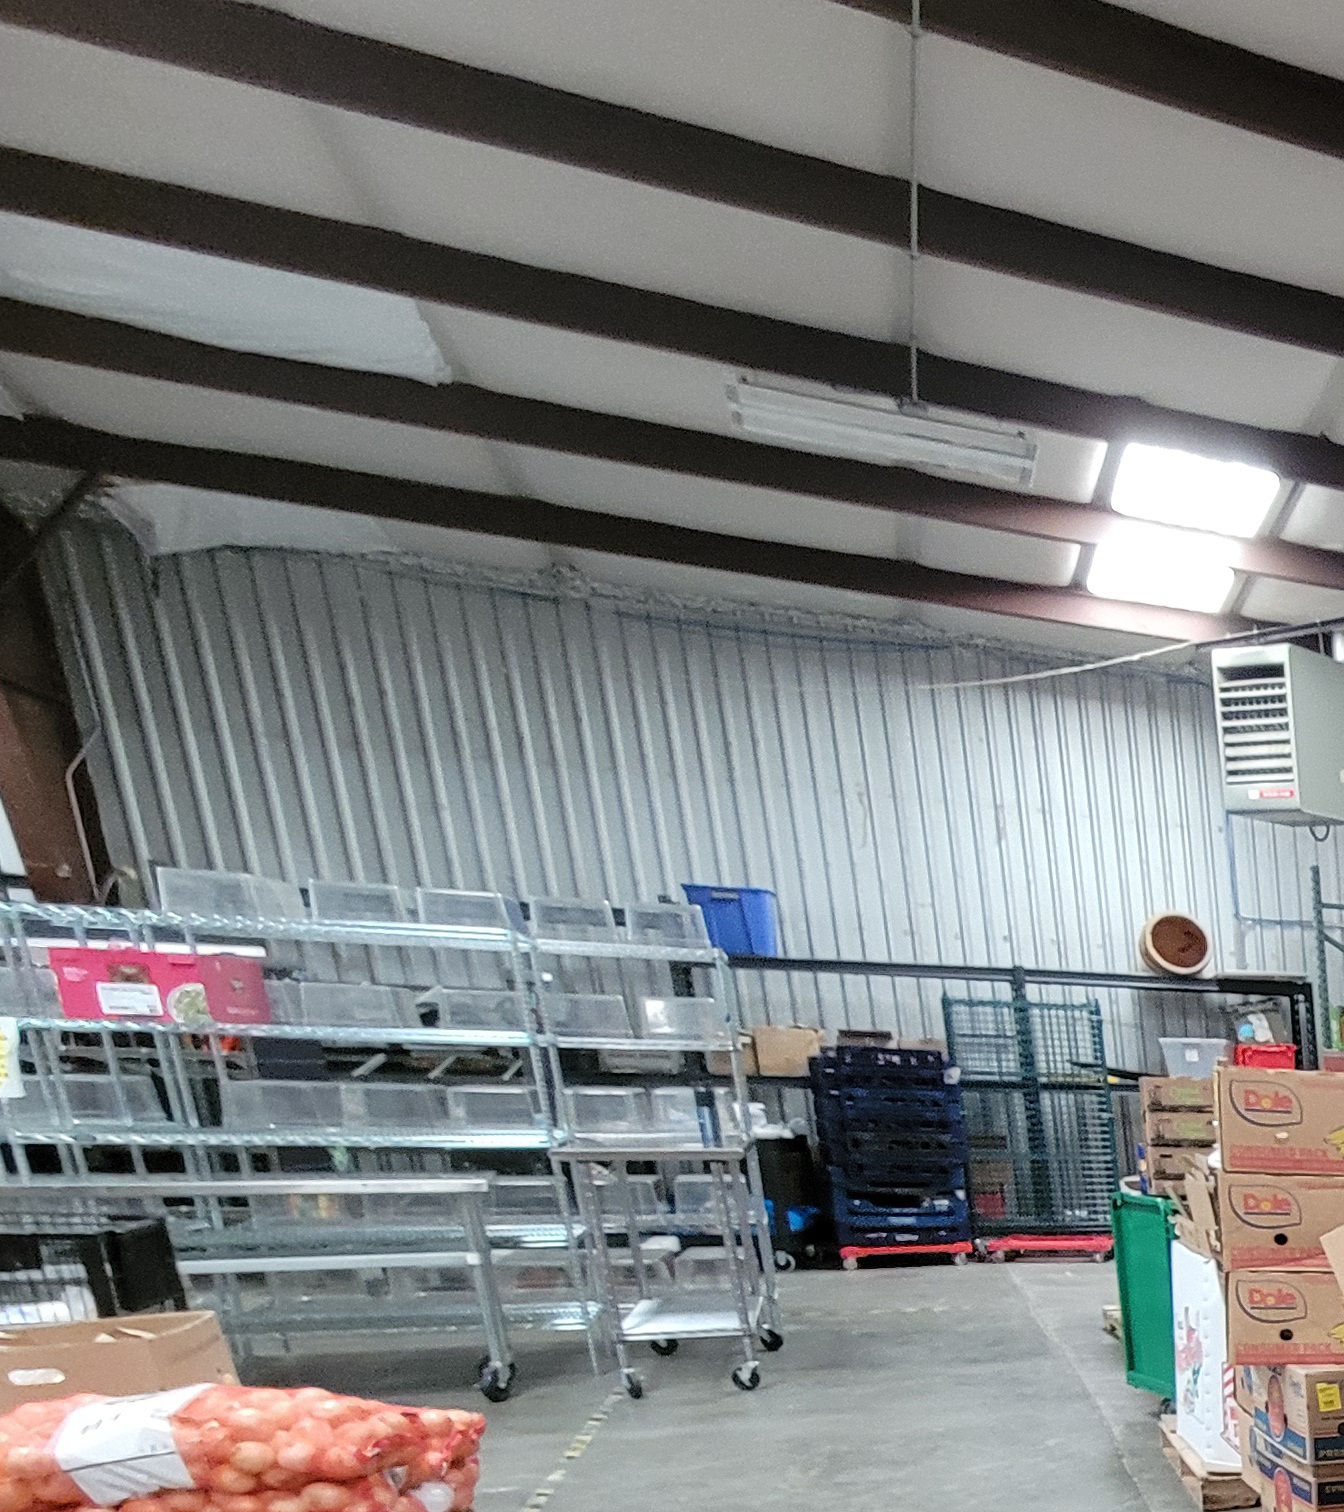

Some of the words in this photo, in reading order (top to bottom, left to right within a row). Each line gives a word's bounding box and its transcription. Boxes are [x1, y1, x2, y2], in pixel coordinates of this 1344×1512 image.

[1243, 1089, 1293, 1109] Dole
[1243, 1192, 1292, 1212] Dole
[1248, 1287, 1297, 1306] Dole
